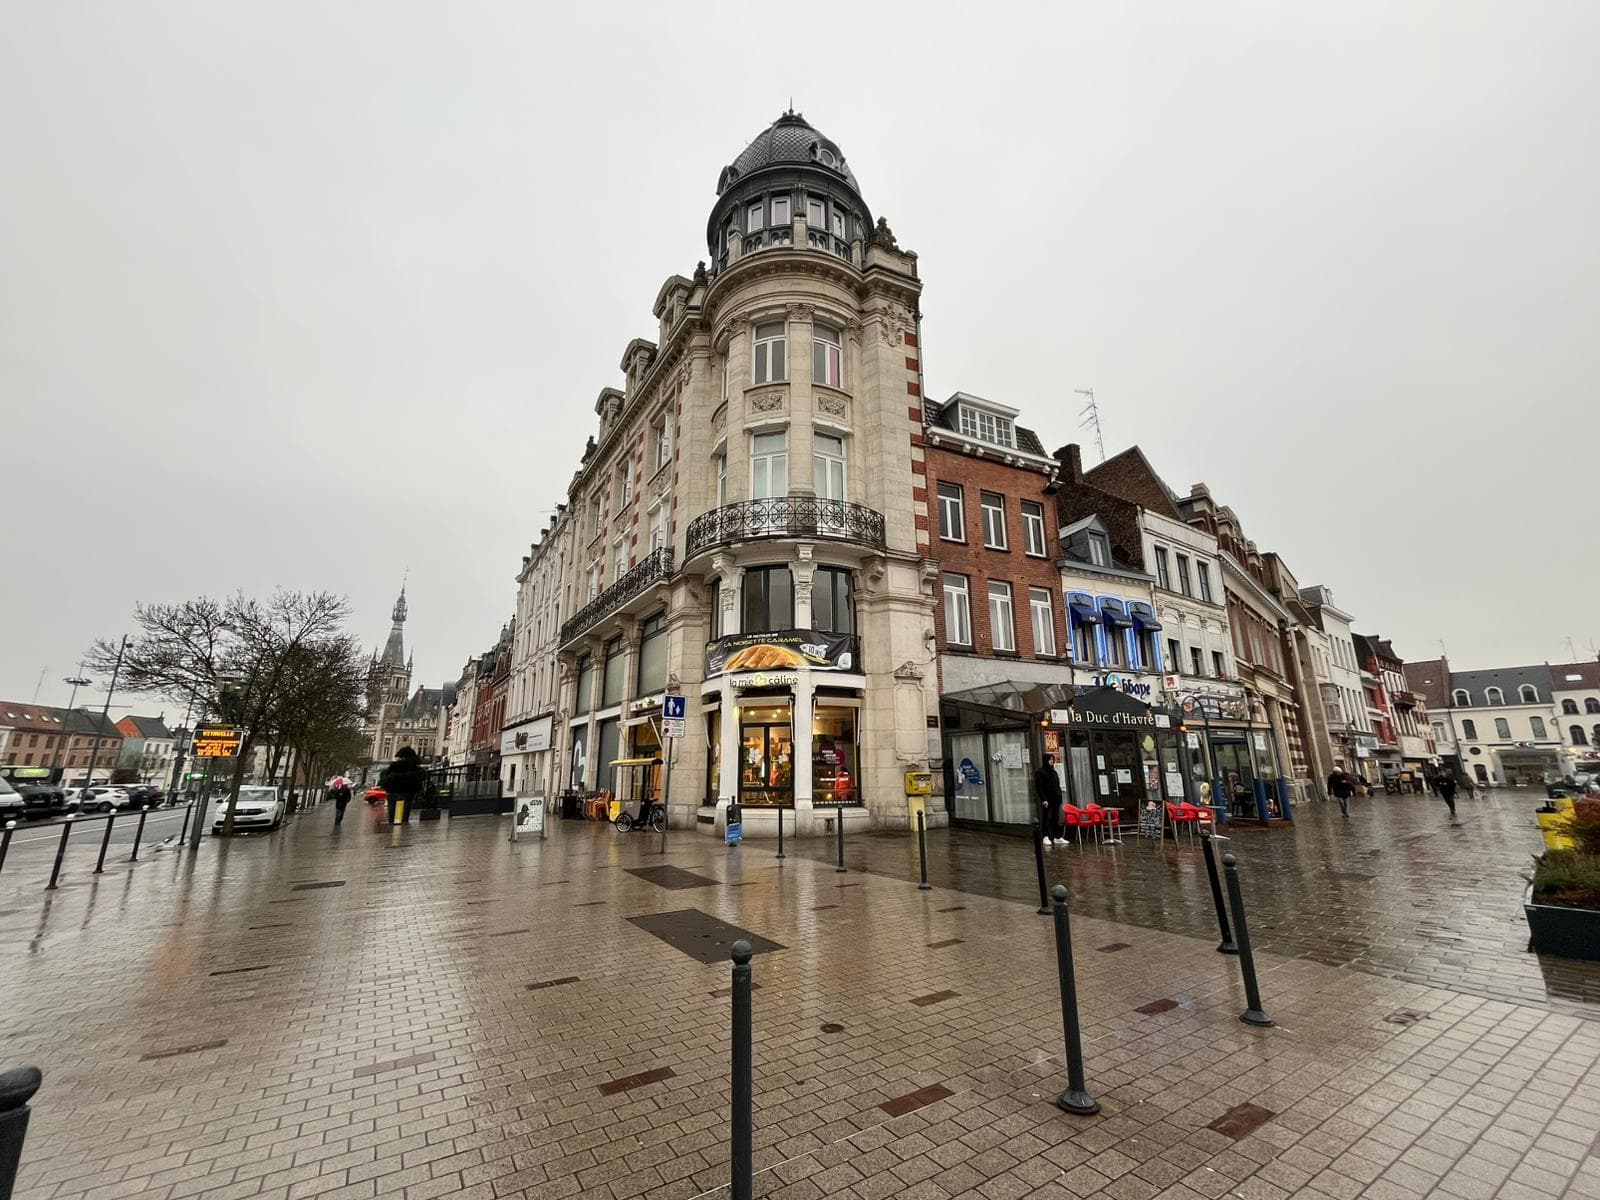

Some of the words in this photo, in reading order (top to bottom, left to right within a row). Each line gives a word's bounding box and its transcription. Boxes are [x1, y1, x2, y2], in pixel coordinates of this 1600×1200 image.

[731, 638, 766, 647] NOISETTE
[729, 678, 737, 688] la
[739, 678, 754, 687] mie
[768, 675, 799, 686] câline
[1070, 710, 1082, 722] la
[1086, 711, 1109, 723] Duc
[1112, 711, 1155, 726] d'Havré
